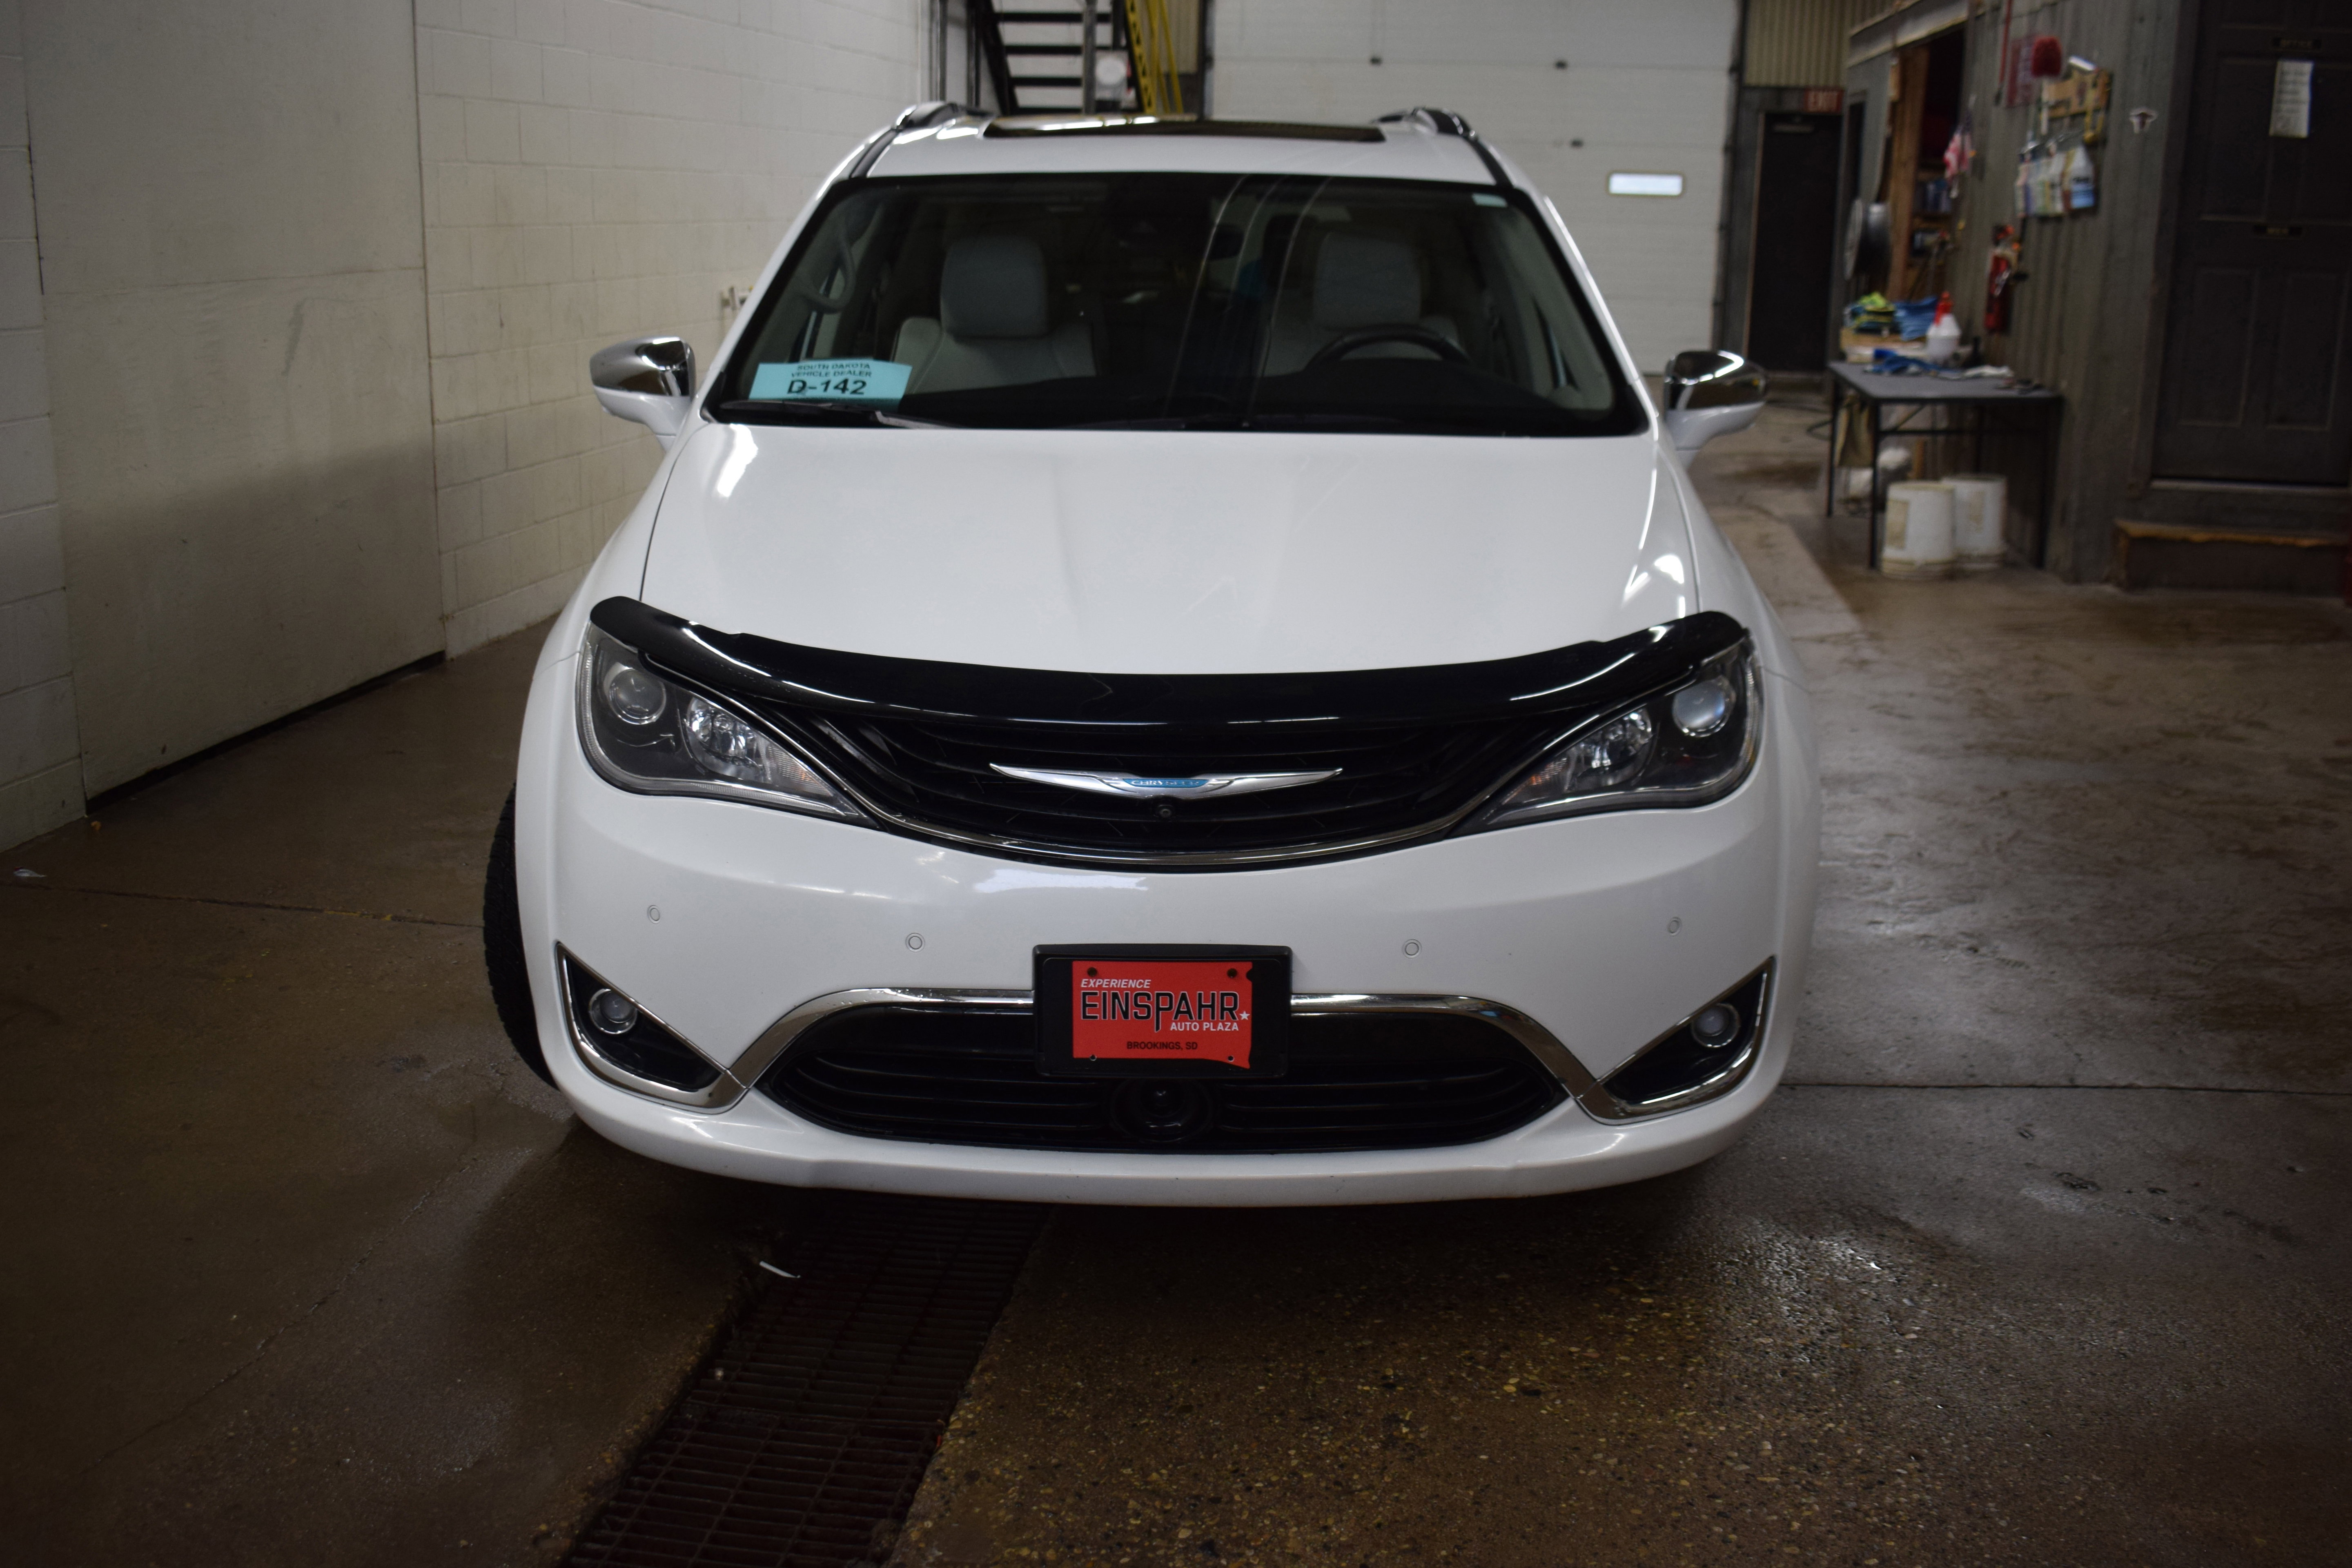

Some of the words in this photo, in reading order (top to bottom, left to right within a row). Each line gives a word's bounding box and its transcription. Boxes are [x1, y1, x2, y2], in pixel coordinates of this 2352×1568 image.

[788, 378, 867, 394] D-142
[1080, 978, 1152, 989] EXPERIENCE
[1081, 991, 1239, 1033] EINSPAHR
[1170, 1022, 1199, 1031] AUTO
[1203, 1022, 1239, 1031] PLAZA
[1127, 1042, 1183, 1050] BROOKINGS,
